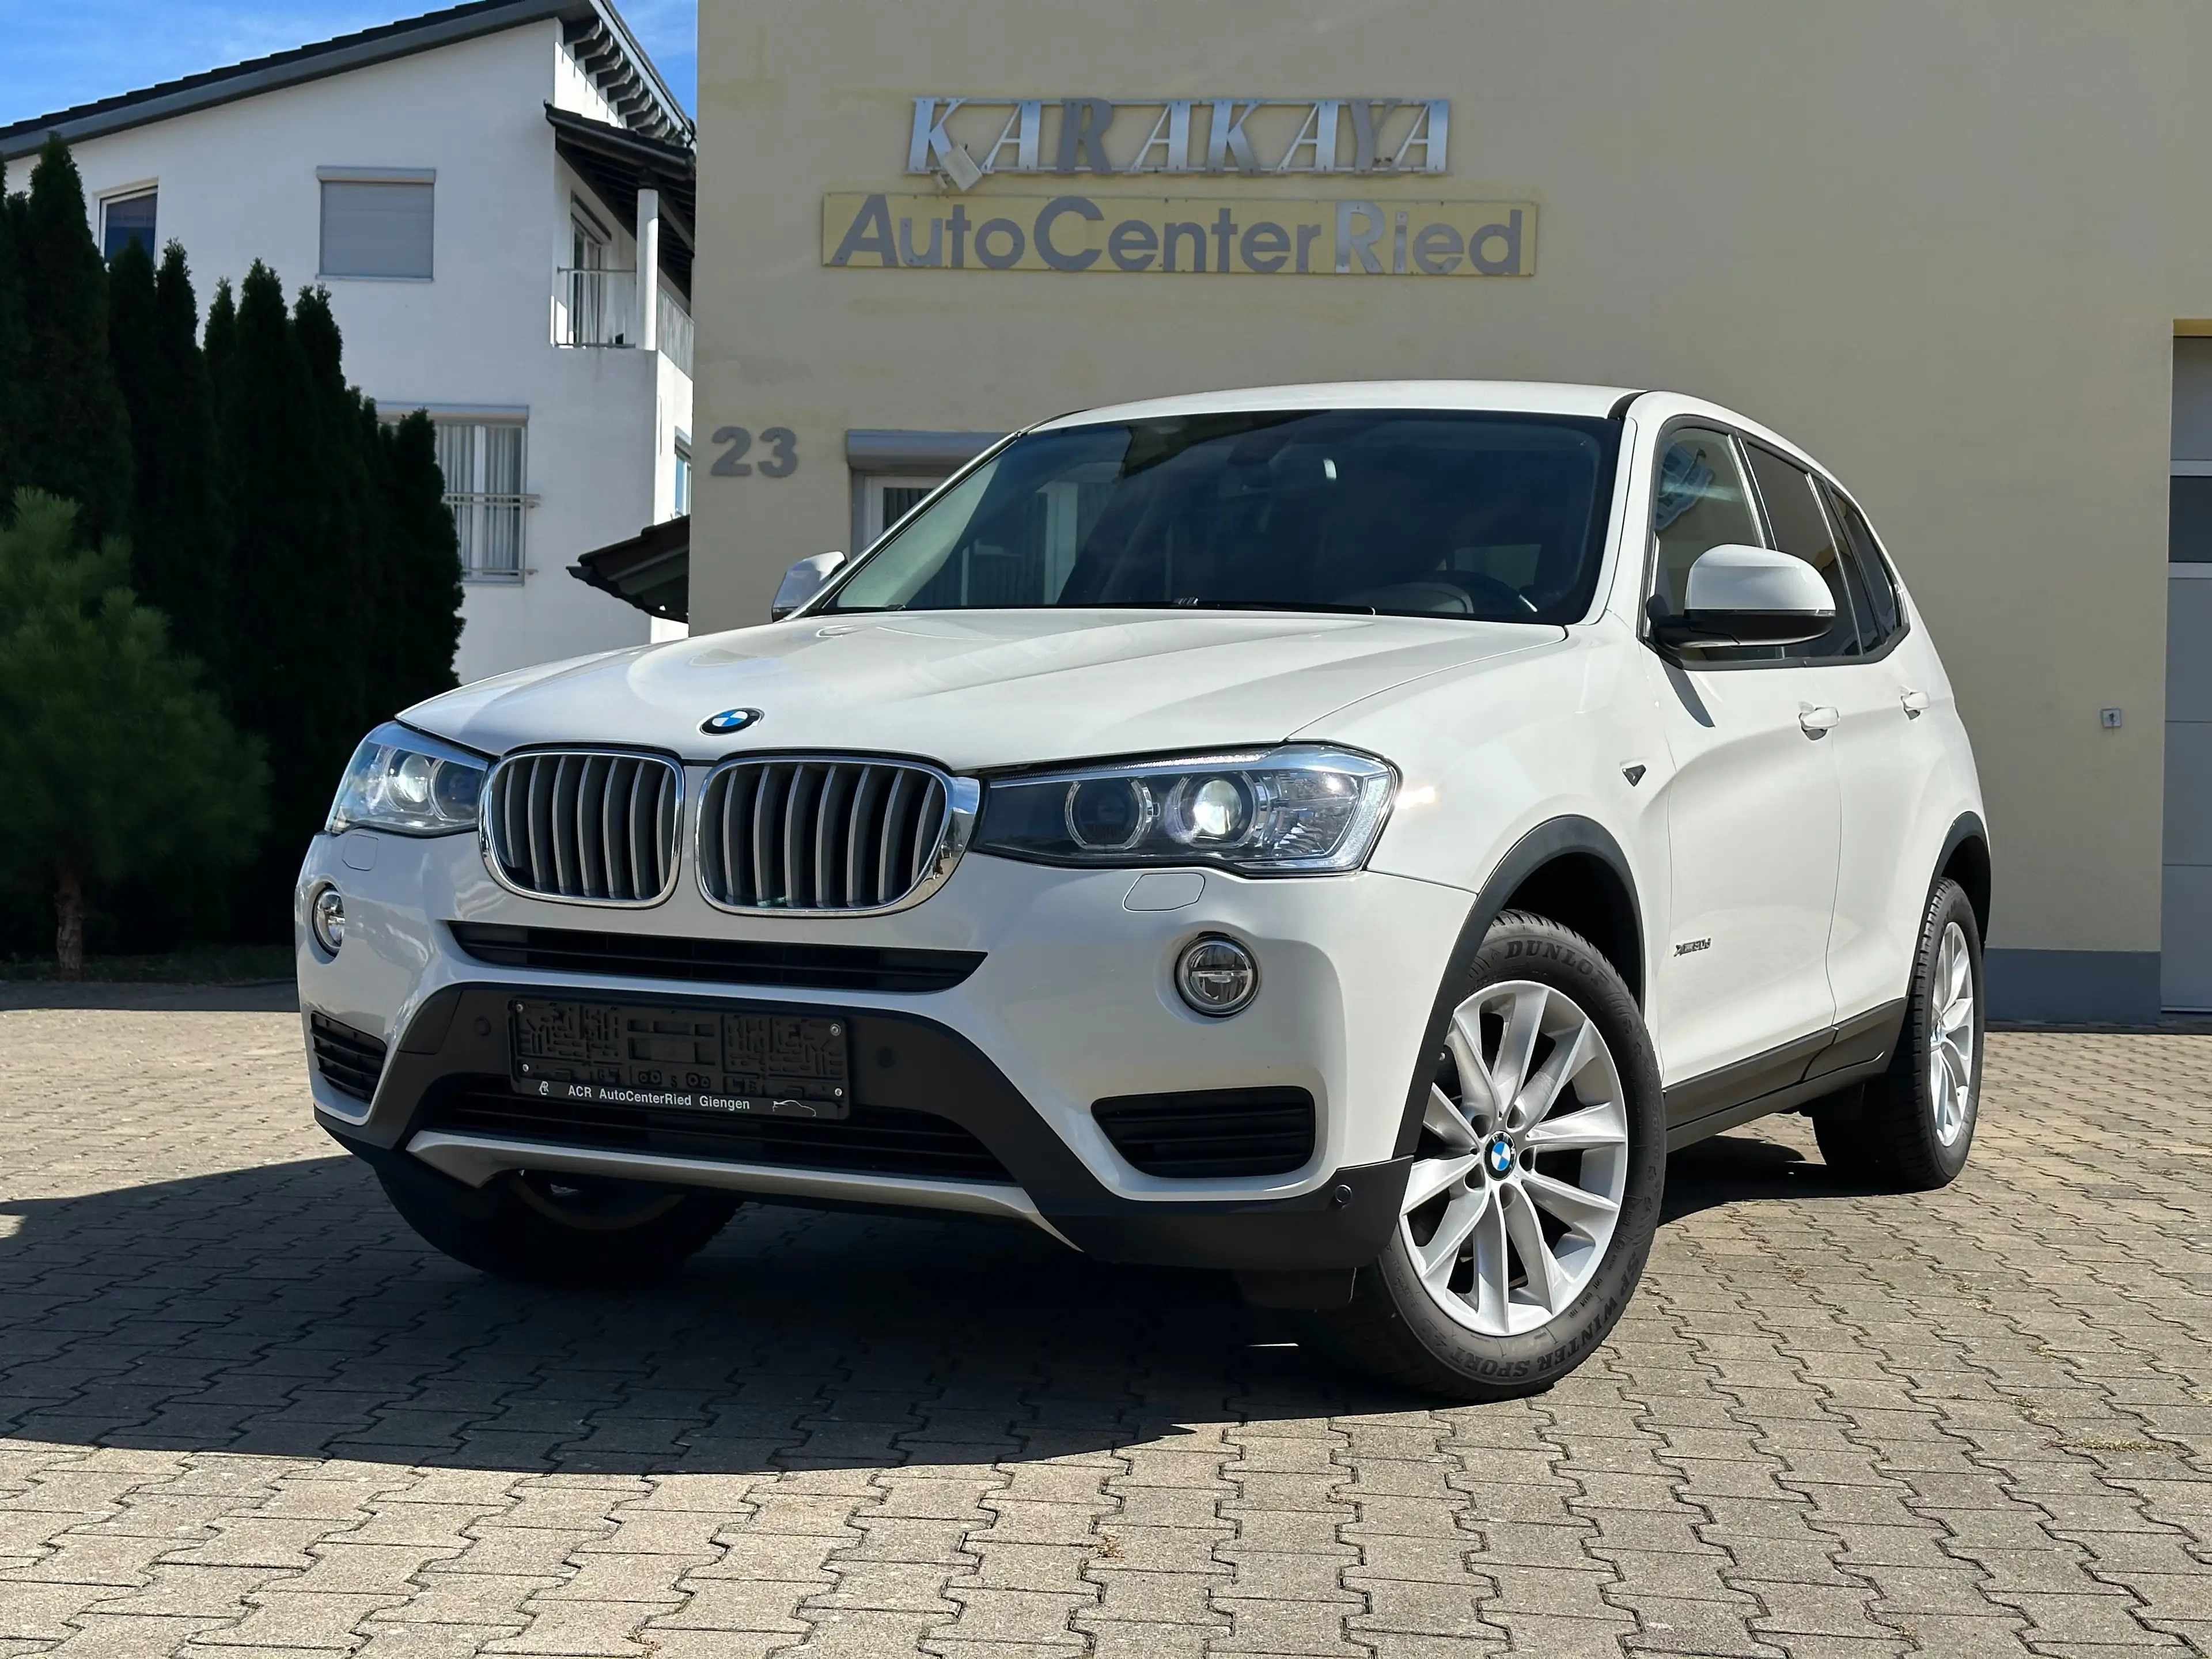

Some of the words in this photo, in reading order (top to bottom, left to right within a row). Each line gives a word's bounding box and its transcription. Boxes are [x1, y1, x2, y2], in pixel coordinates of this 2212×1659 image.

[904, 97, 1452, 175] KARAKAYA
[710, 426, 798, 478] 23
[569, 1085, 592, 1098] ACR
[600, 1088, 692, 1106] AutoCenterRied
[699, 1095, 750, 1111] Giengen
[1536, 1296, 1619, 1372] WINTER
[1449, 1346, 1531, 1377] SPORT
